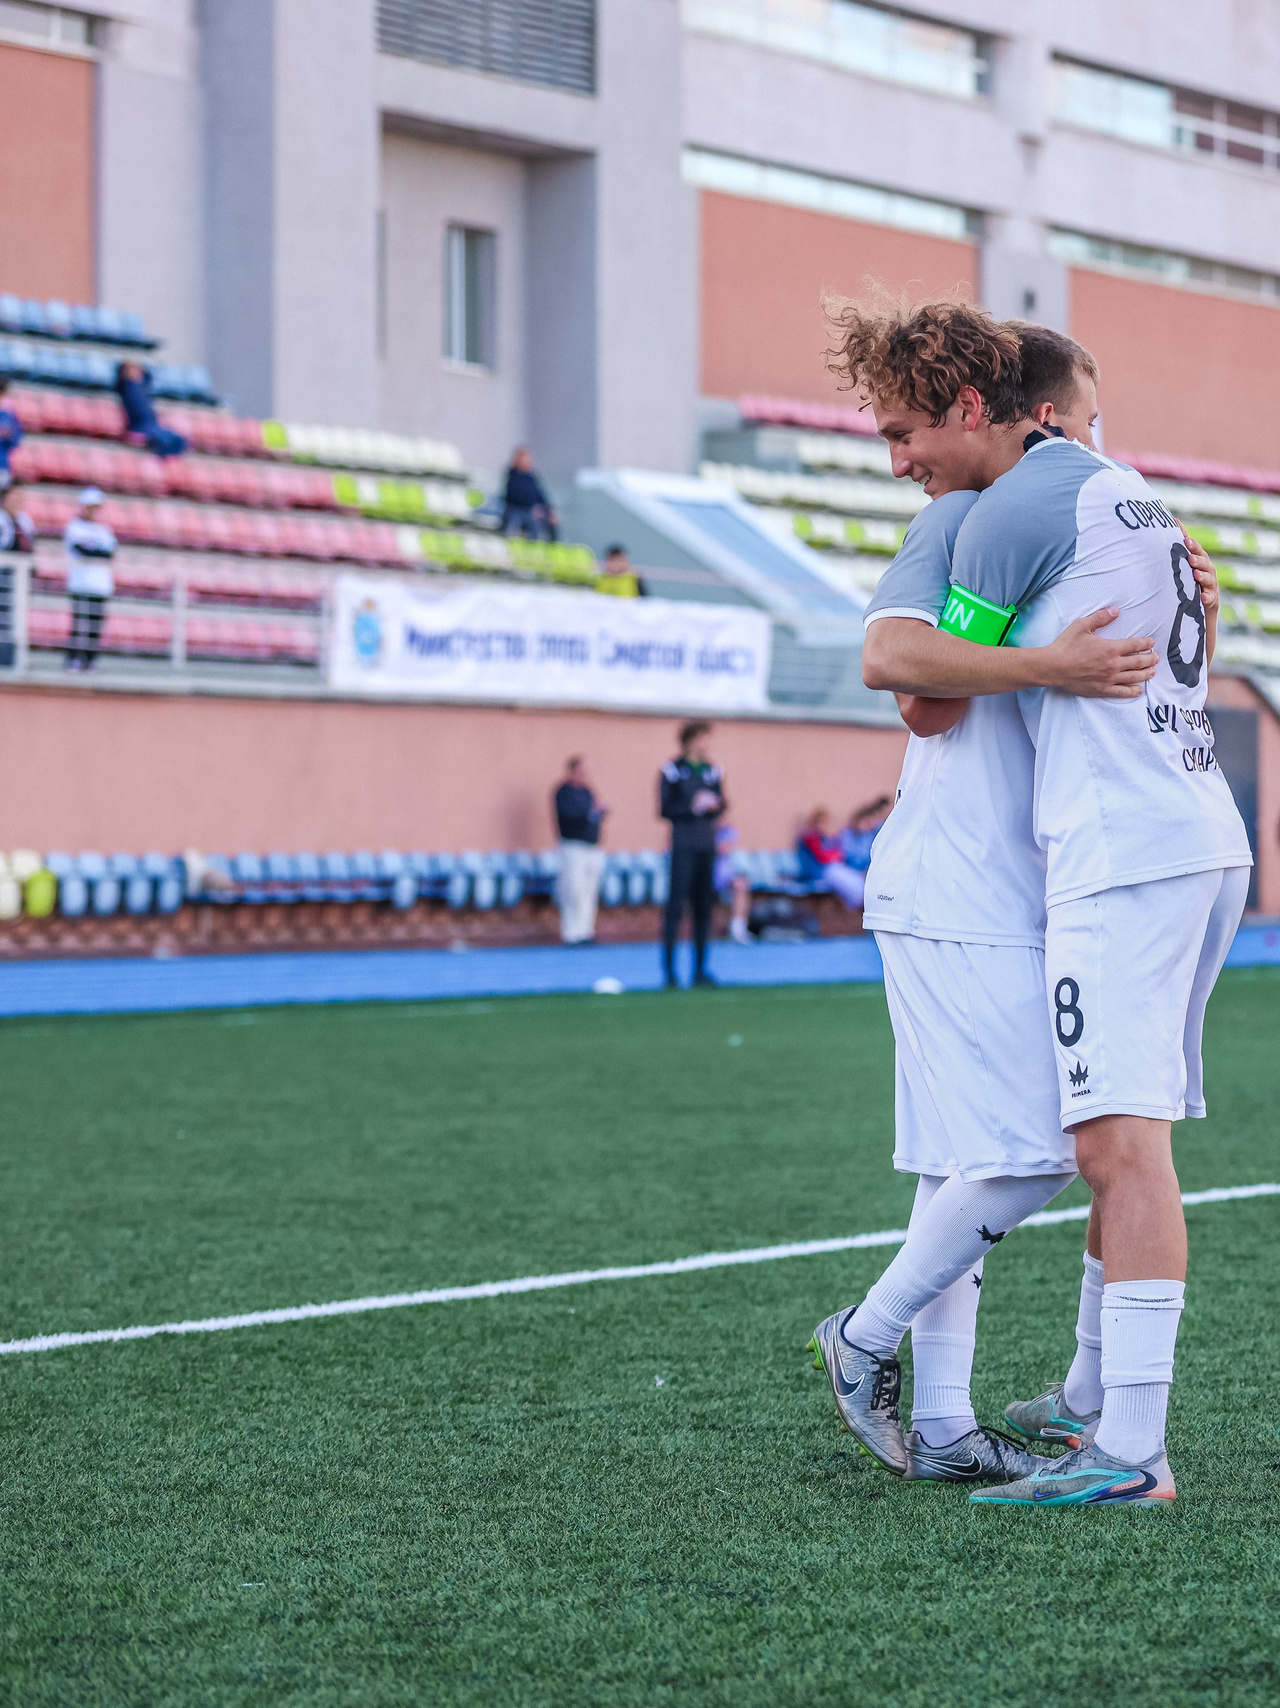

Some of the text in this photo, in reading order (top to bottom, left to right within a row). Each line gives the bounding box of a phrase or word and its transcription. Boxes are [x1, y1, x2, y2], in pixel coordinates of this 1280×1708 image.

[1167, 542, 1205, 688] 8
[1054, 977, 1084, 1047] 8
[1071, 1089, 1091, 1098] PRIMERA
